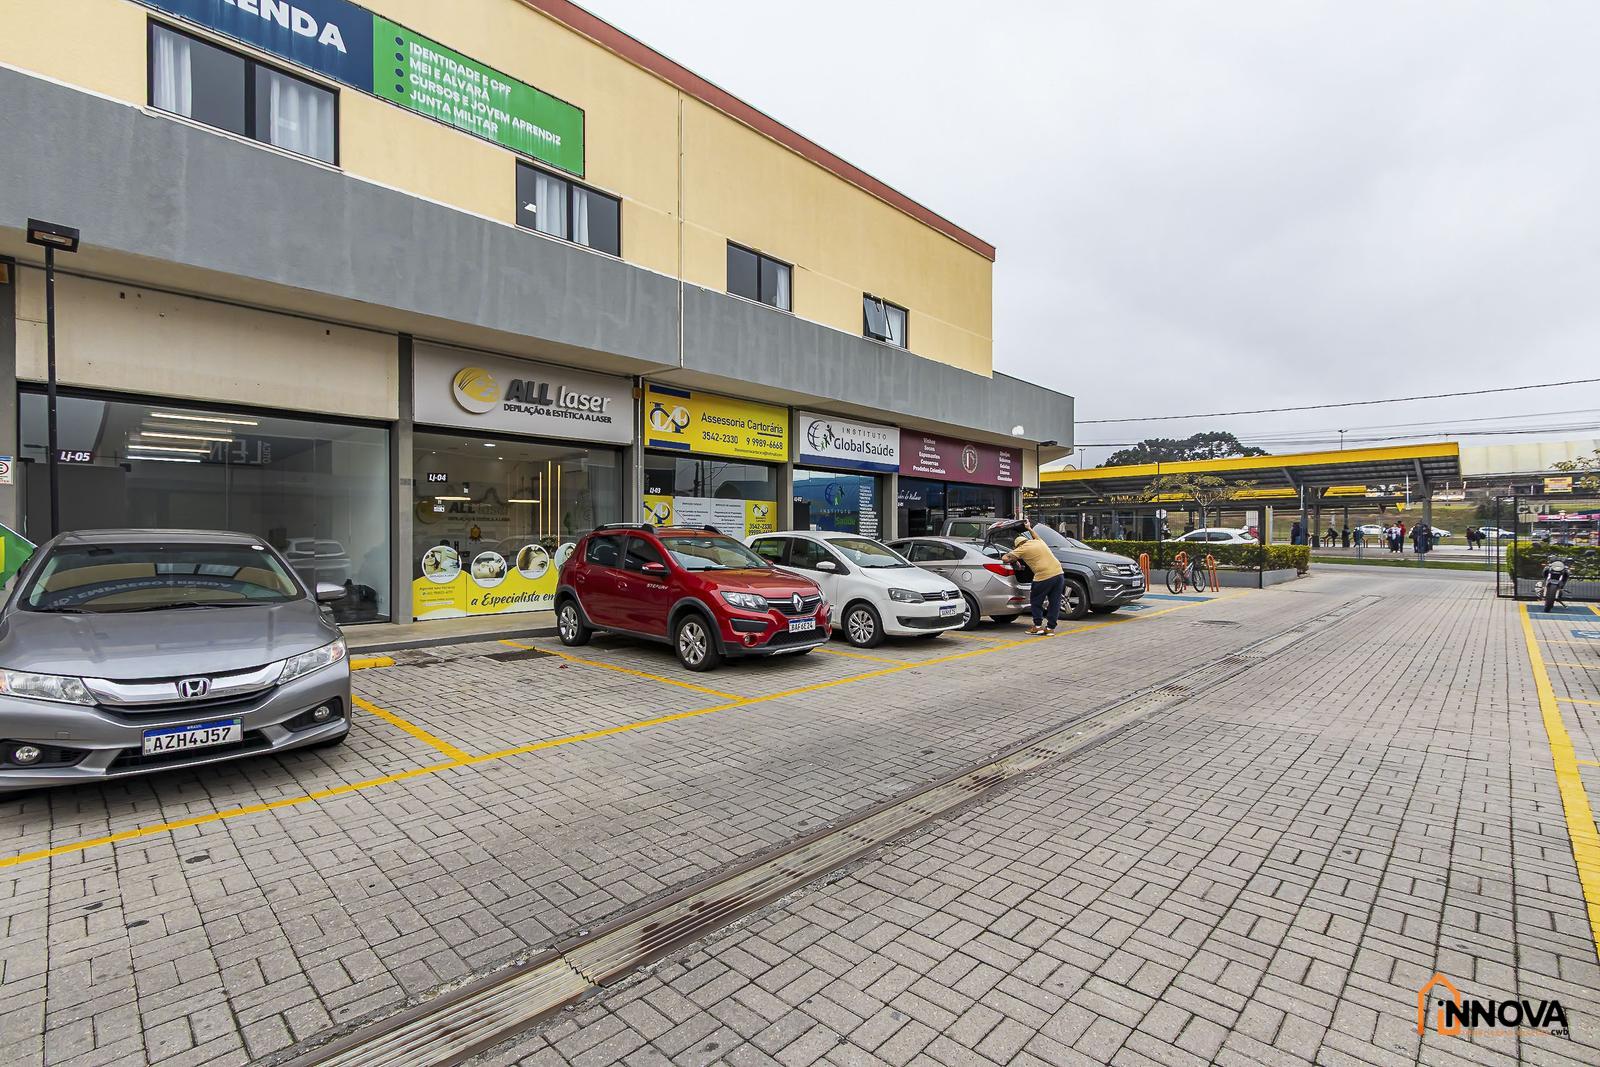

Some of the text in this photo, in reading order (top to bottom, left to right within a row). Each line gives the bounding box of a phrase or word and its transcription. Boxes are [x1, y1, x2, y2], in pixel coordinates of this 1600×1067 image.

[409, 42, 512, 95] IDENTIDADE E CPF
[409, 57, 490, 101] MEI E ALVARÁ
[409, 73, 561, 145] CURSOS E JOVEM APRENDIZ
[410, 90, 499, 133] JUNTA MILITAR
[504, 379, 612, 413] ALL laser
[503, 403, 612, 424] DEPILAÇÃO & ESTÉTICA A LASER
[701, 411, 783, 434] Assessoria Cartorária
[702, 431, 739, 445] 3542-2330
[841, 427, 888, 440] INSTITUTO
[60, 451, 91, 462] Lj-05
[471, 597, 479, 606] a
[481, 590, 540, 608] Especialista
[153, 727, 231, 751] AZH4J57
